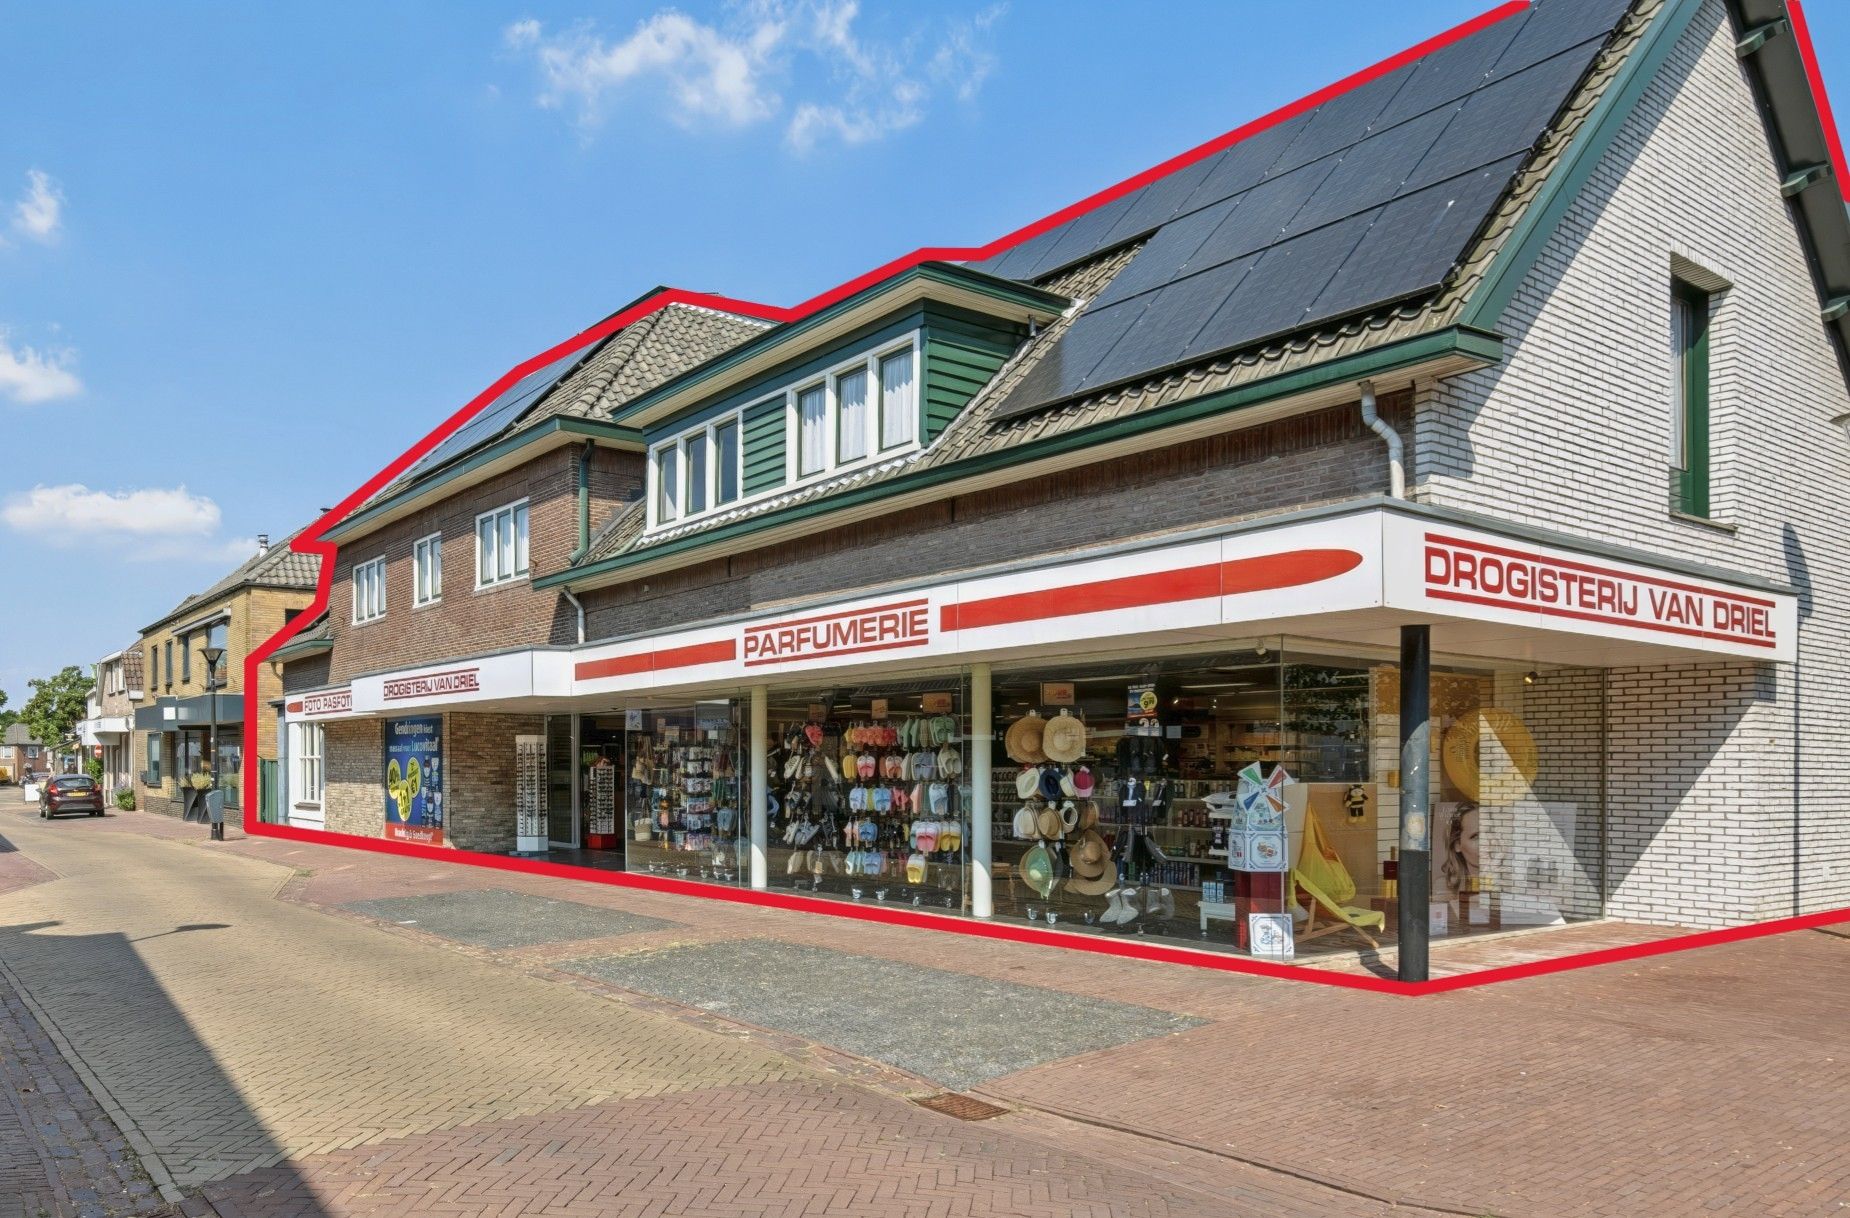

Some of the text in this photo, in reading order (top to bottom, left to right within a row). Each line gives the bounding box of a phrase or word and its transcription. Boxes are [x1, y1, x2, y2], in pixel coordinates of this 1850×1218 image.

[1425, 546, 1776, 638] DROGISTERIJ VAN DRIEL
[744, 608, 928, 659] PARFUMERIE
[305, 694, 352, 711] FOTO PASFOT
[384, 673, 479, 697] DROGISTERIJ VAN DRIEL
